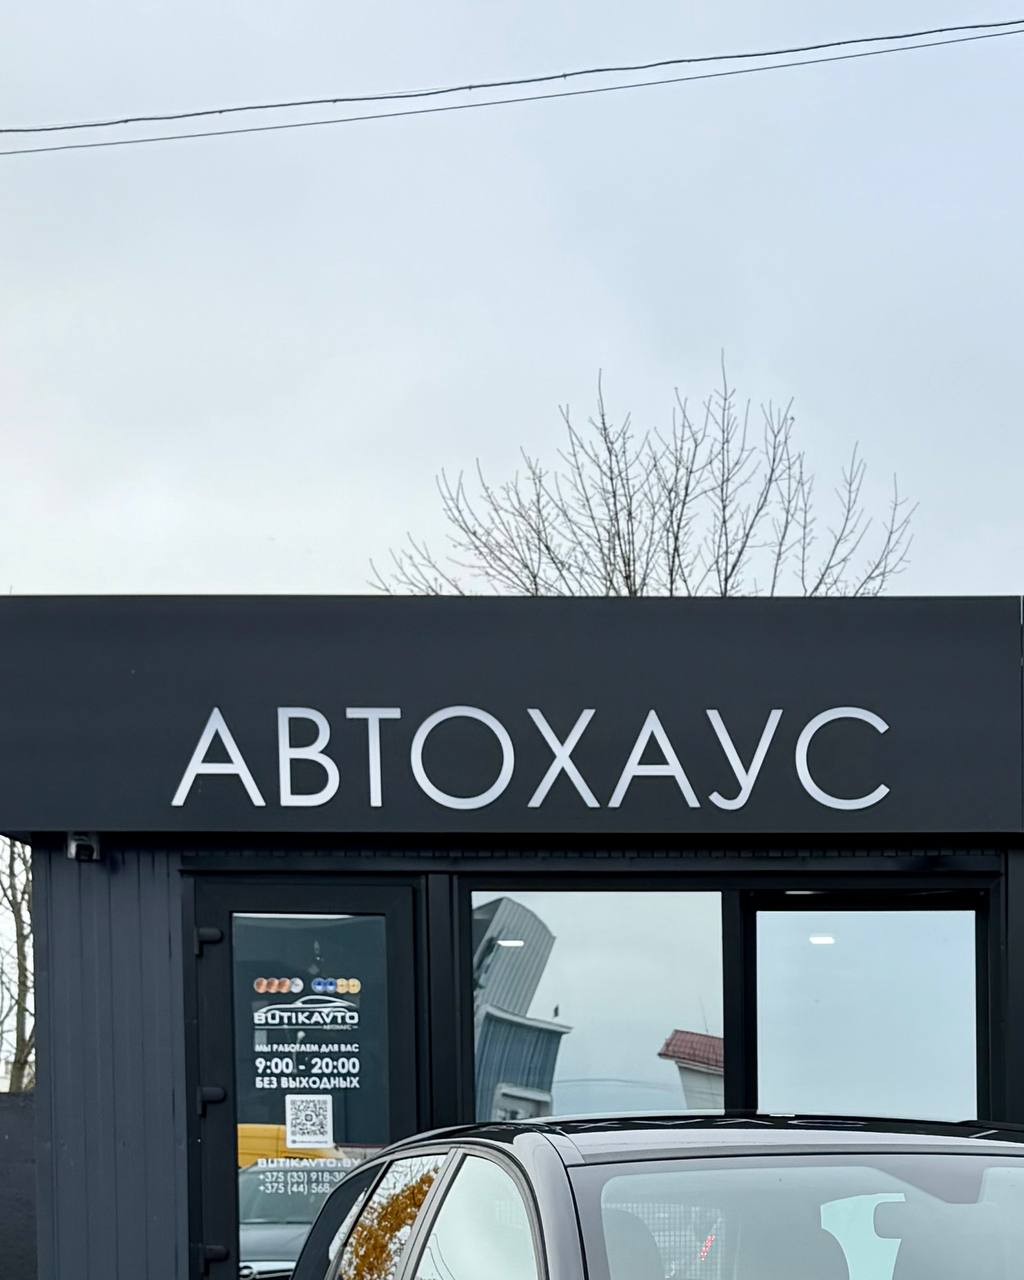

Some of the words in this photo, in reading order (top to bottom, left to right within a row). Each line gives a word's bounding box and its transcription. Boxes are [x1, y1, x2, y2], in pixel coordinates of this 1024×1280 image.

[171, 705, 891, 811] АВТОХАУС
[253, 1012, 360, 1025] BUTIKAVTO
[272, 1044, 319, 1053] РАБОТАЕМ
[320, 1044, 339, 1054] ДЛЯ
[340, 1044, 360, 1053] ВАС
[255, 1057, 293, 1074] 9:00
[311, 1057, 360, 1074] 20:00
[255, 1077, 278, 1089] БЕЗ
[281, 1077, 360, 1090] ВЫХОДНЫХ
[257, 1158, 361, 1168] BUTIKAVTO.BY
[259, 1172, 285, 1182] +375
[287, 1171, 308, 1183] (33)
[259, 1183, 285, 1193] +375
[287, 1182, 308, 1195] (44)
